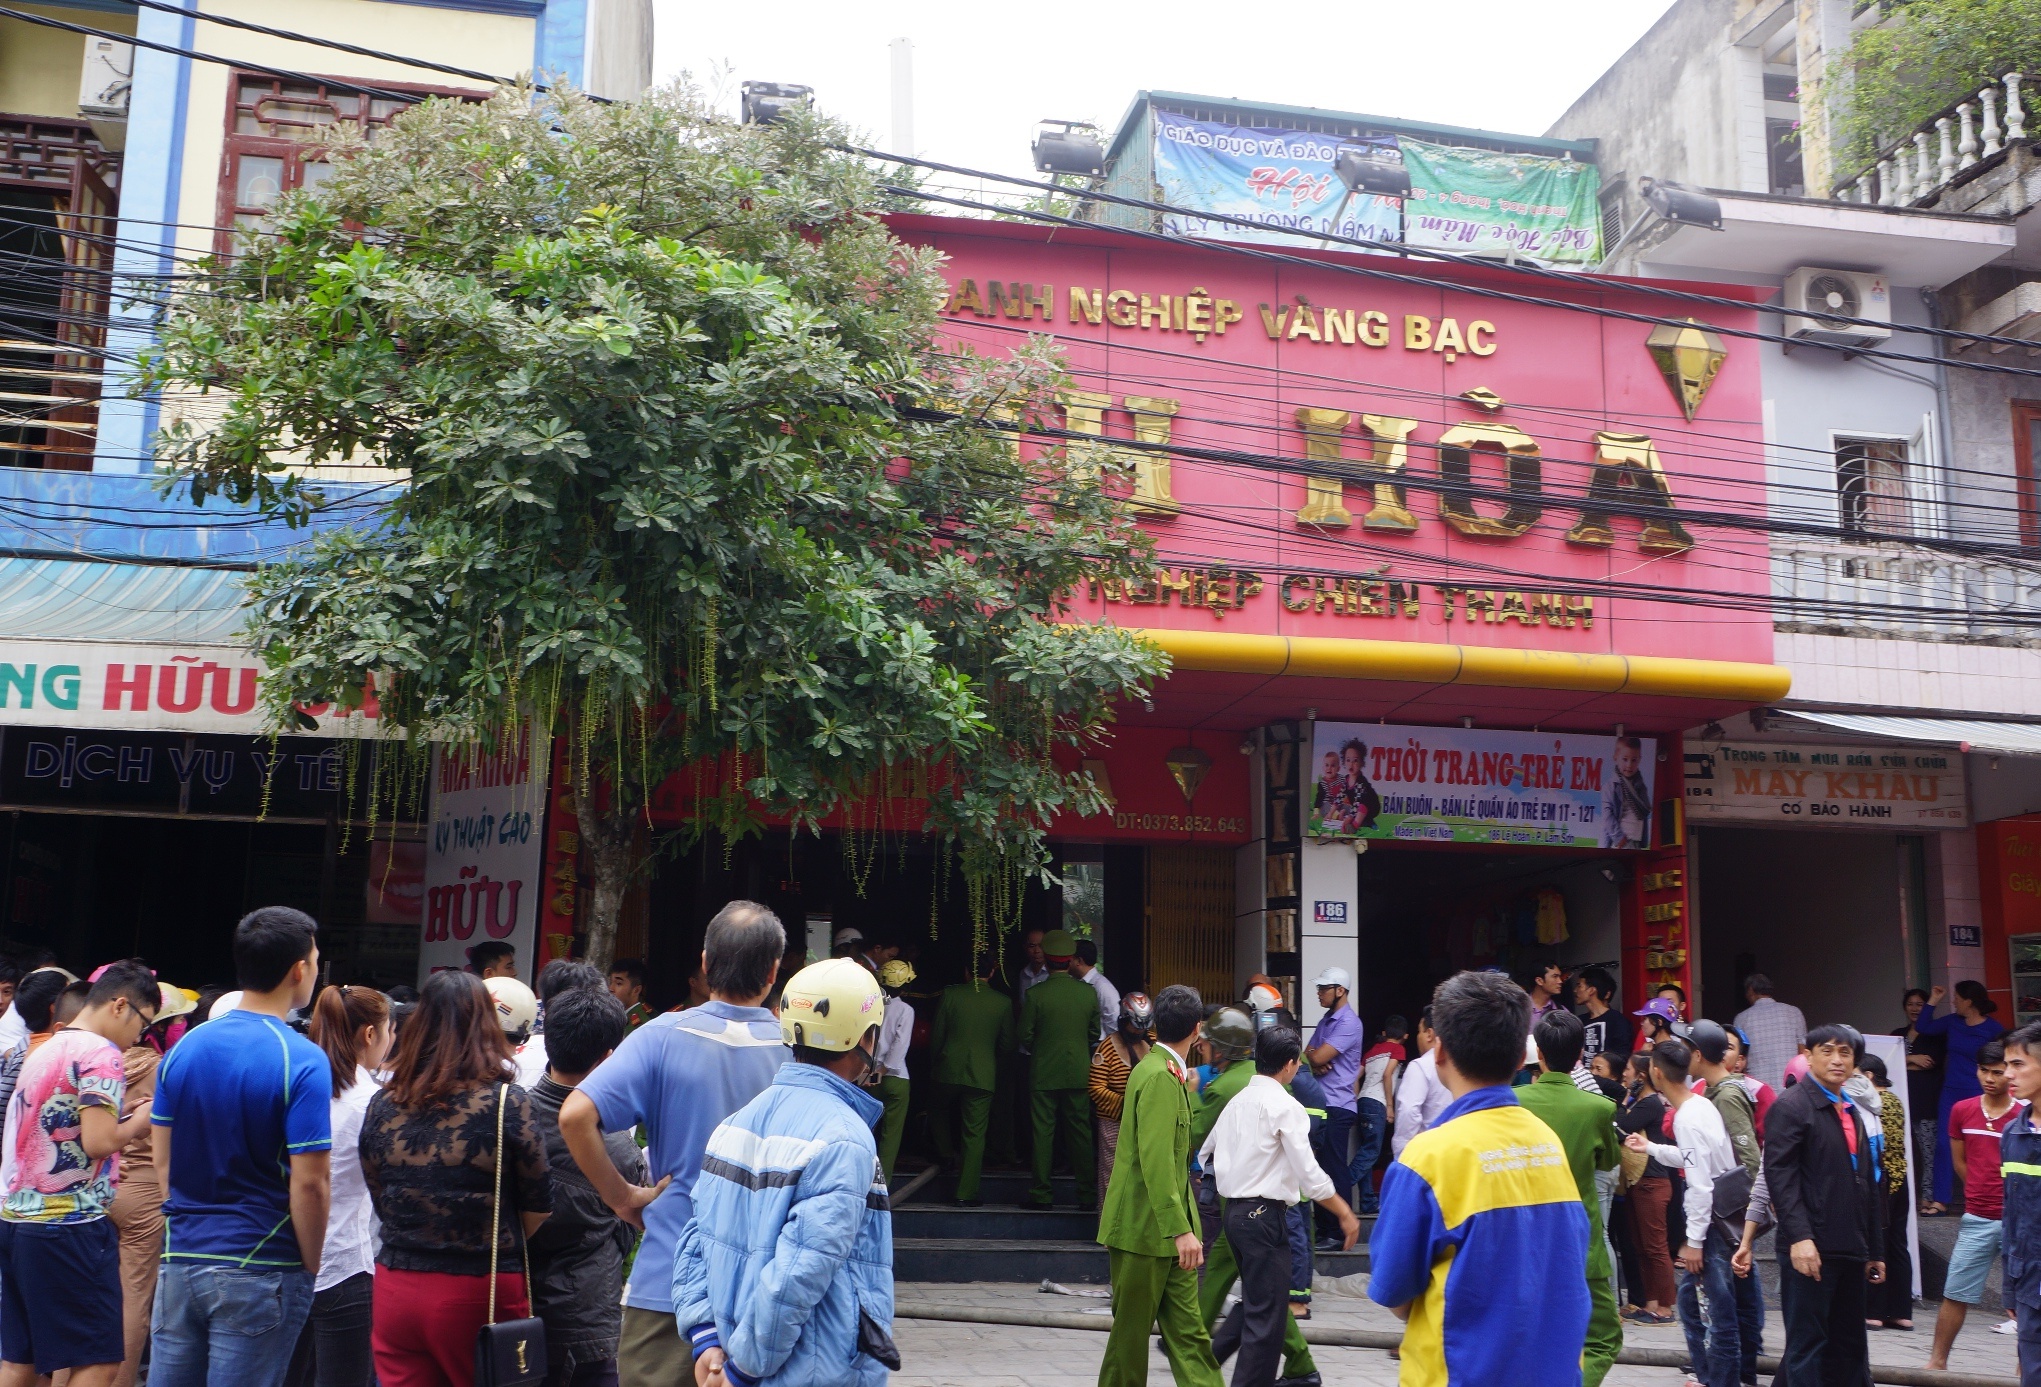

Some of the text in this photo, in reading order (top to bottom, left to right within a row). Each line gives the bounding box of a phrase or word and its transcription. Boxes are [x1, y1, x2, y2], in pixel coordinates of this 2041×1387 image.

[1164, 123, 1212, 147] GIÁO
[1216, 135, 1257, 157] DỤC
[1259, 137, 1286, 158] VÀ
[1291, 142, 1334, 160] ĐÀO
[1246, 166, 1330, 209] Hội
[1069, 286, 1243, 344] NGHIỆP
[1258, 294, 1389, 347] VÀNG
[1404, 314, 1498, 363] BẠC
[103, 656, 258, 716] HỮU
[24, 736, 152, 788] DỊCH
[168, 747, 235, 794] VỤ
[250, 751, 286, 788] Y
[1371, 738, 1603, 791] THỜI TRANG TRẺ EM
[1686, 788, 1713, 797] 184
[1732, 764, 1813, 798] MÁY
[1383, 795, 1403, 814] BÁN
[1405, 796, 1432, 815] BUÔN
[1441, 798, 1461, 817] BÁN
[1464, 794, 1475, 818] LẺ
[1477, 795, 1503, 820] QUẦN
[1506, 797, 1519, 819] ÁO
[1521, 797, 1538, 820] TRẺ
[1540, 802, 1556, 821] EM
[1559, 803, 1570, 822] 1T
[1578, 805, 1595, 823] 12T
[1781, 800, 1803, 816] CÓ
[1850, 802, 1892, 819] HÀNH
[425, 865, 523, 942] HỮU
[1317, 903, 1345, 917] 186
